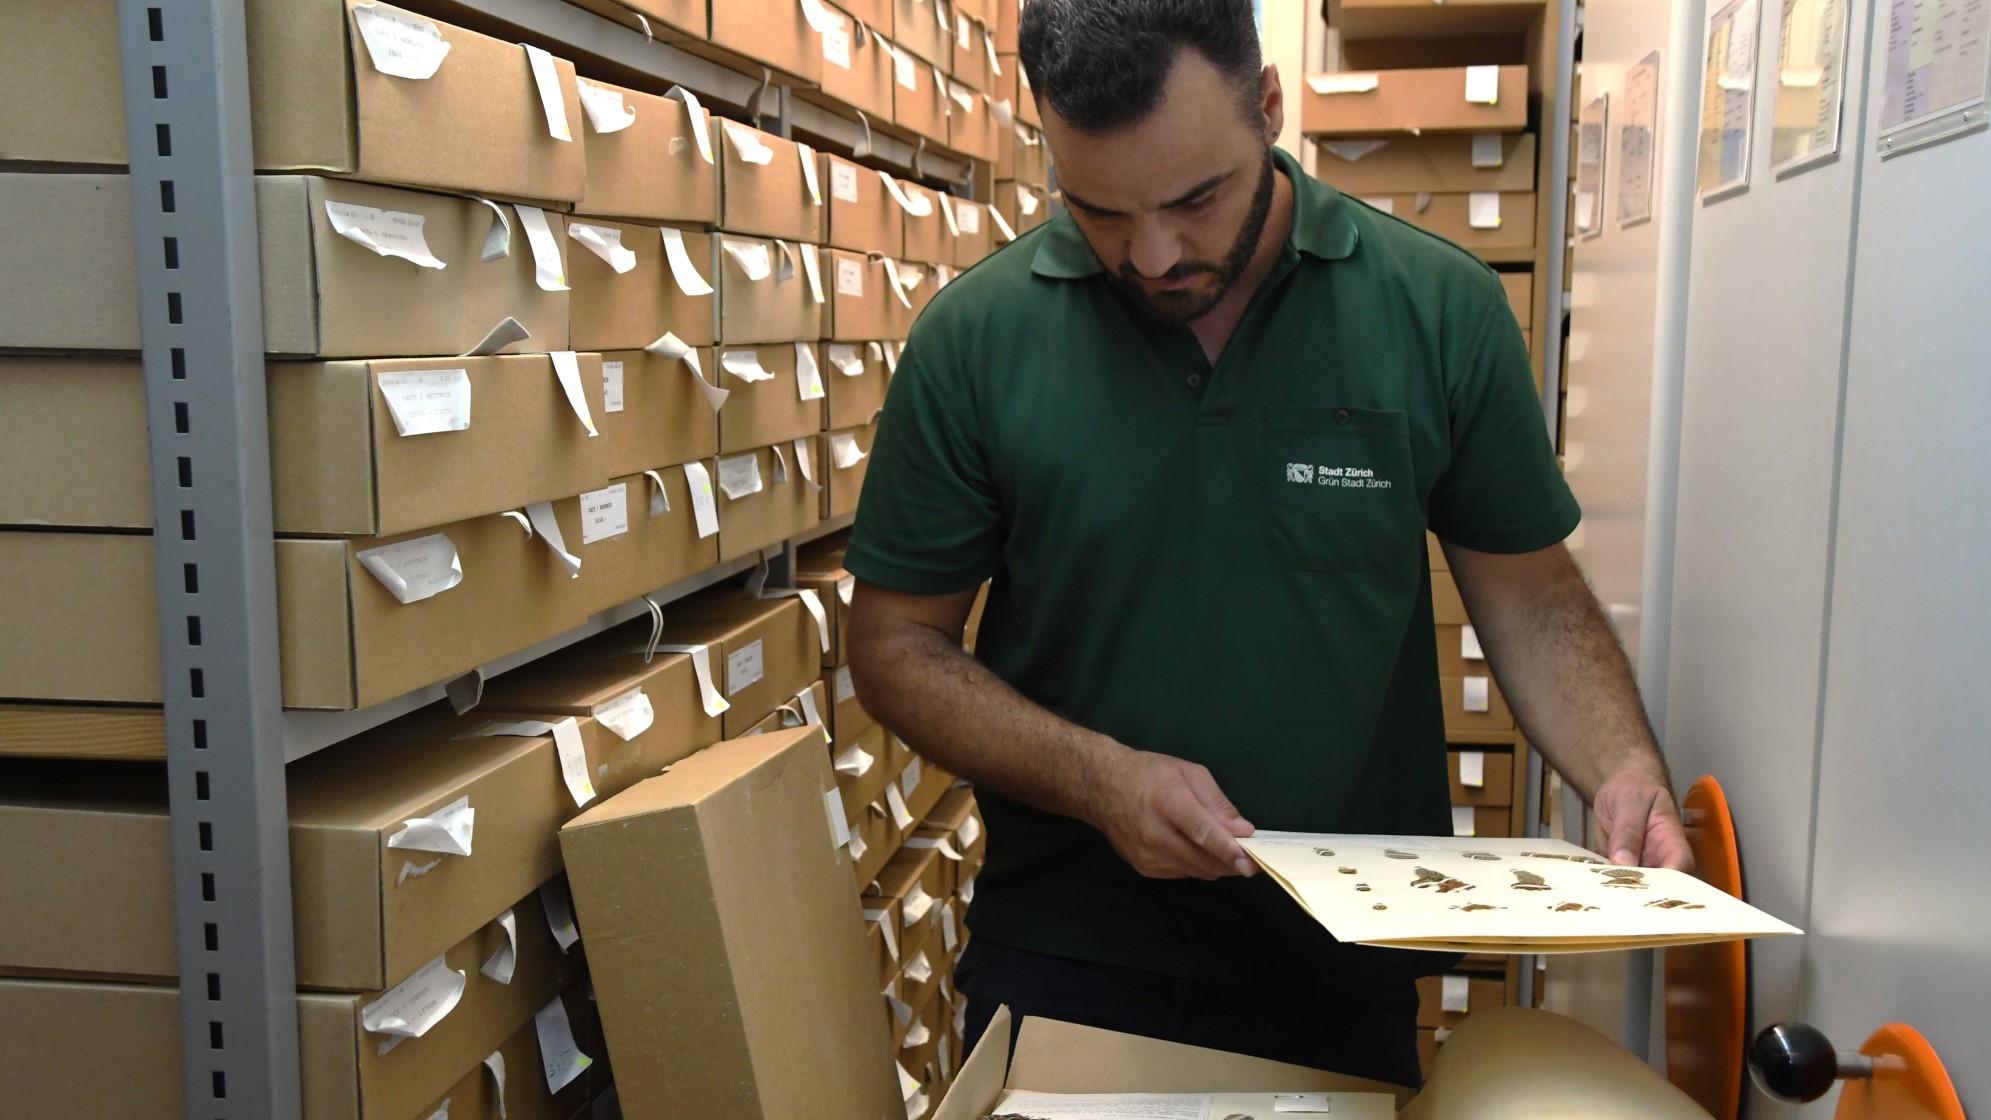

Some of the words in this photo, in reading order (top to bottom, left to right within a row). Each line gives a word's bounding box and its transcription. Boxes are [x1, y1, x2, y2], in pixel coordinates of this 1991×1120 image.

[1318, 466, 1343, 476] Stadt
[1344, 467, 1374, 478] Zürich
[1318, 476, 1339, 486] Grün
[1341, 477, 1365, 488] Stadt
[1366, 479, 1391, 488] Zürich
